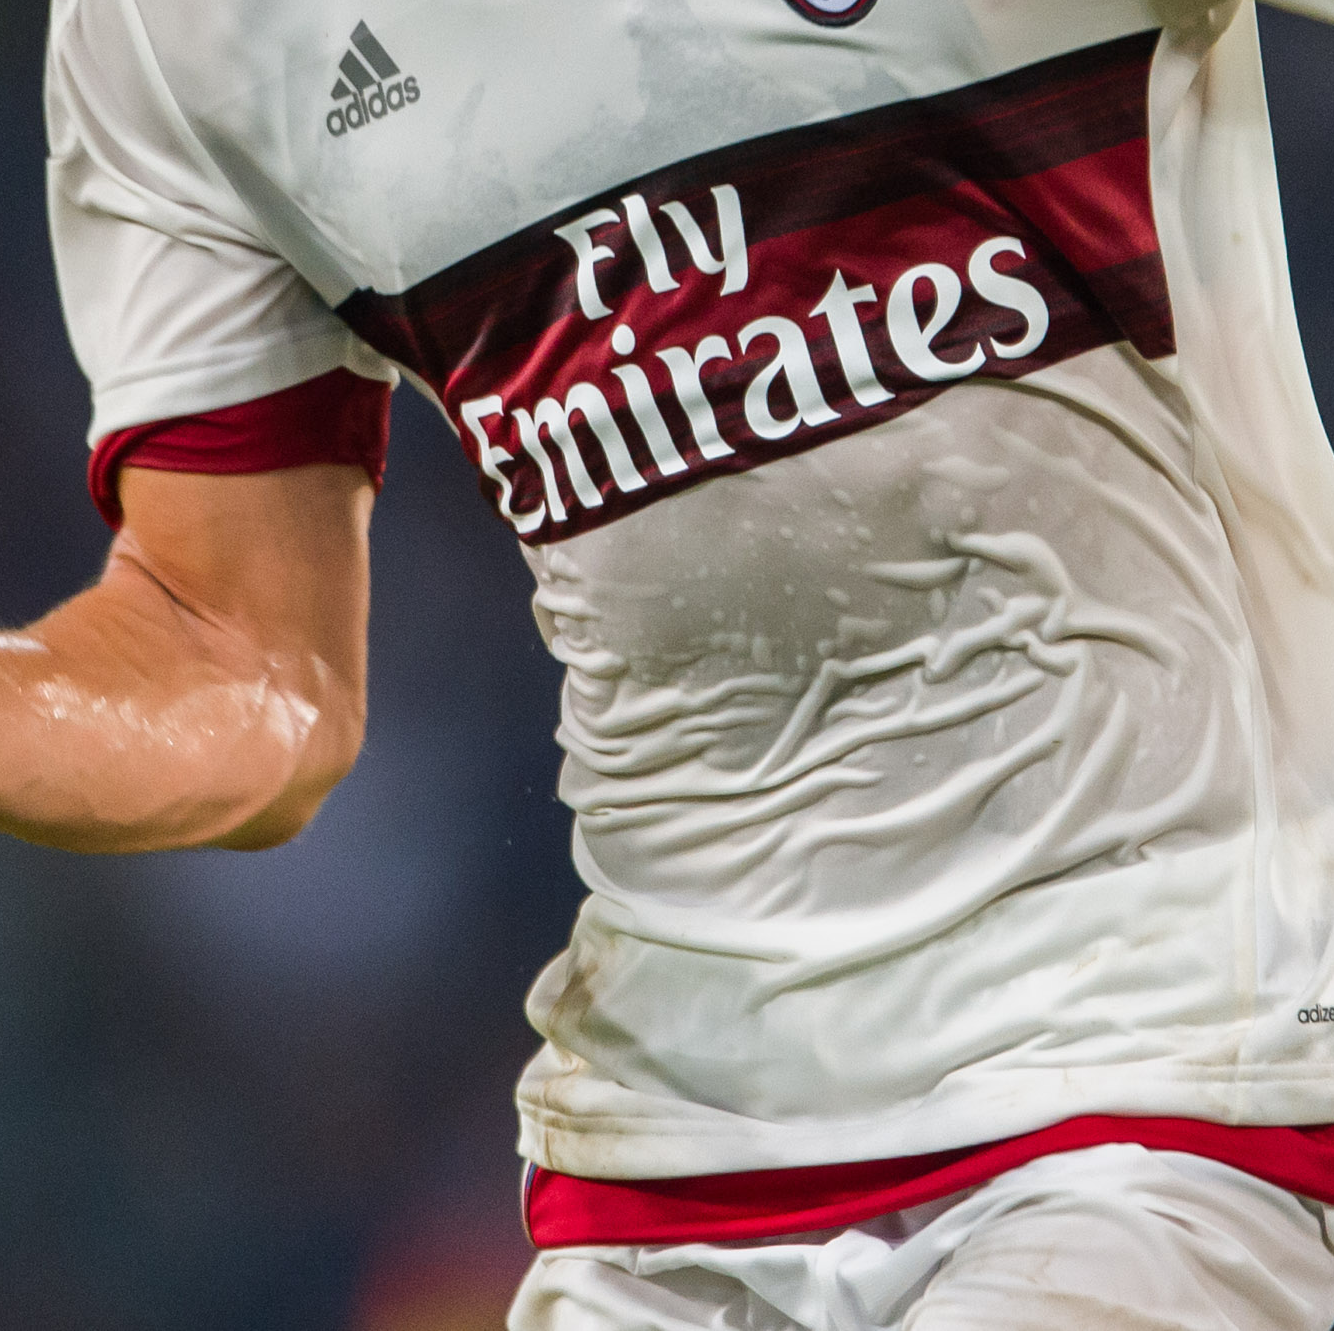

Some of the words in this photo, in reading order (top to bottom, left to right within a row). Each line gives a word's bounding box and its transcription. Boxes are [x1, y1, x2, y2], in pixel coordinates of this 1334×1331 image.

[326, 75, 421, 138] adidas
[554, 183, 749, 320] Fly
[460, 235, 1049, 535] Emirates
